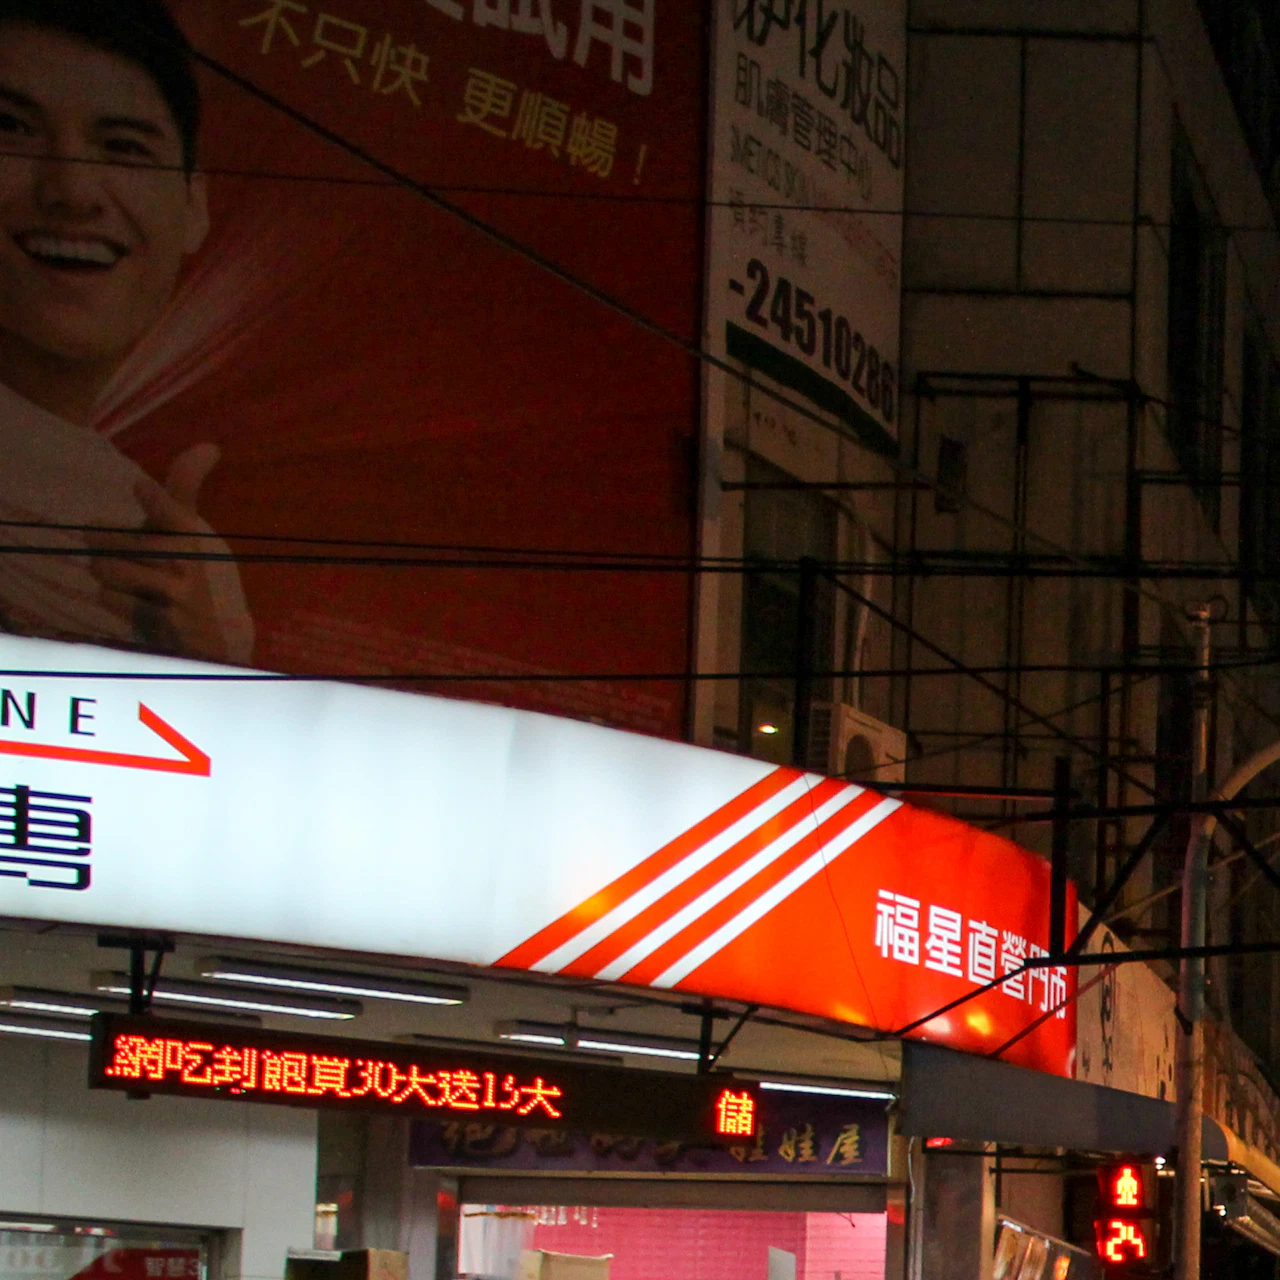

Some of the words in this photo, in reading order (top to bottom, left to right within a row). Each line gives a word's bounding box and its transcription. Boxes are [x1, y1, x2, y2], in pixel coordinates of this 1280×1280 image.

[239, 0, 430, 107] 不只快
[874, 889, 1067, 1020] 福星直營門市
